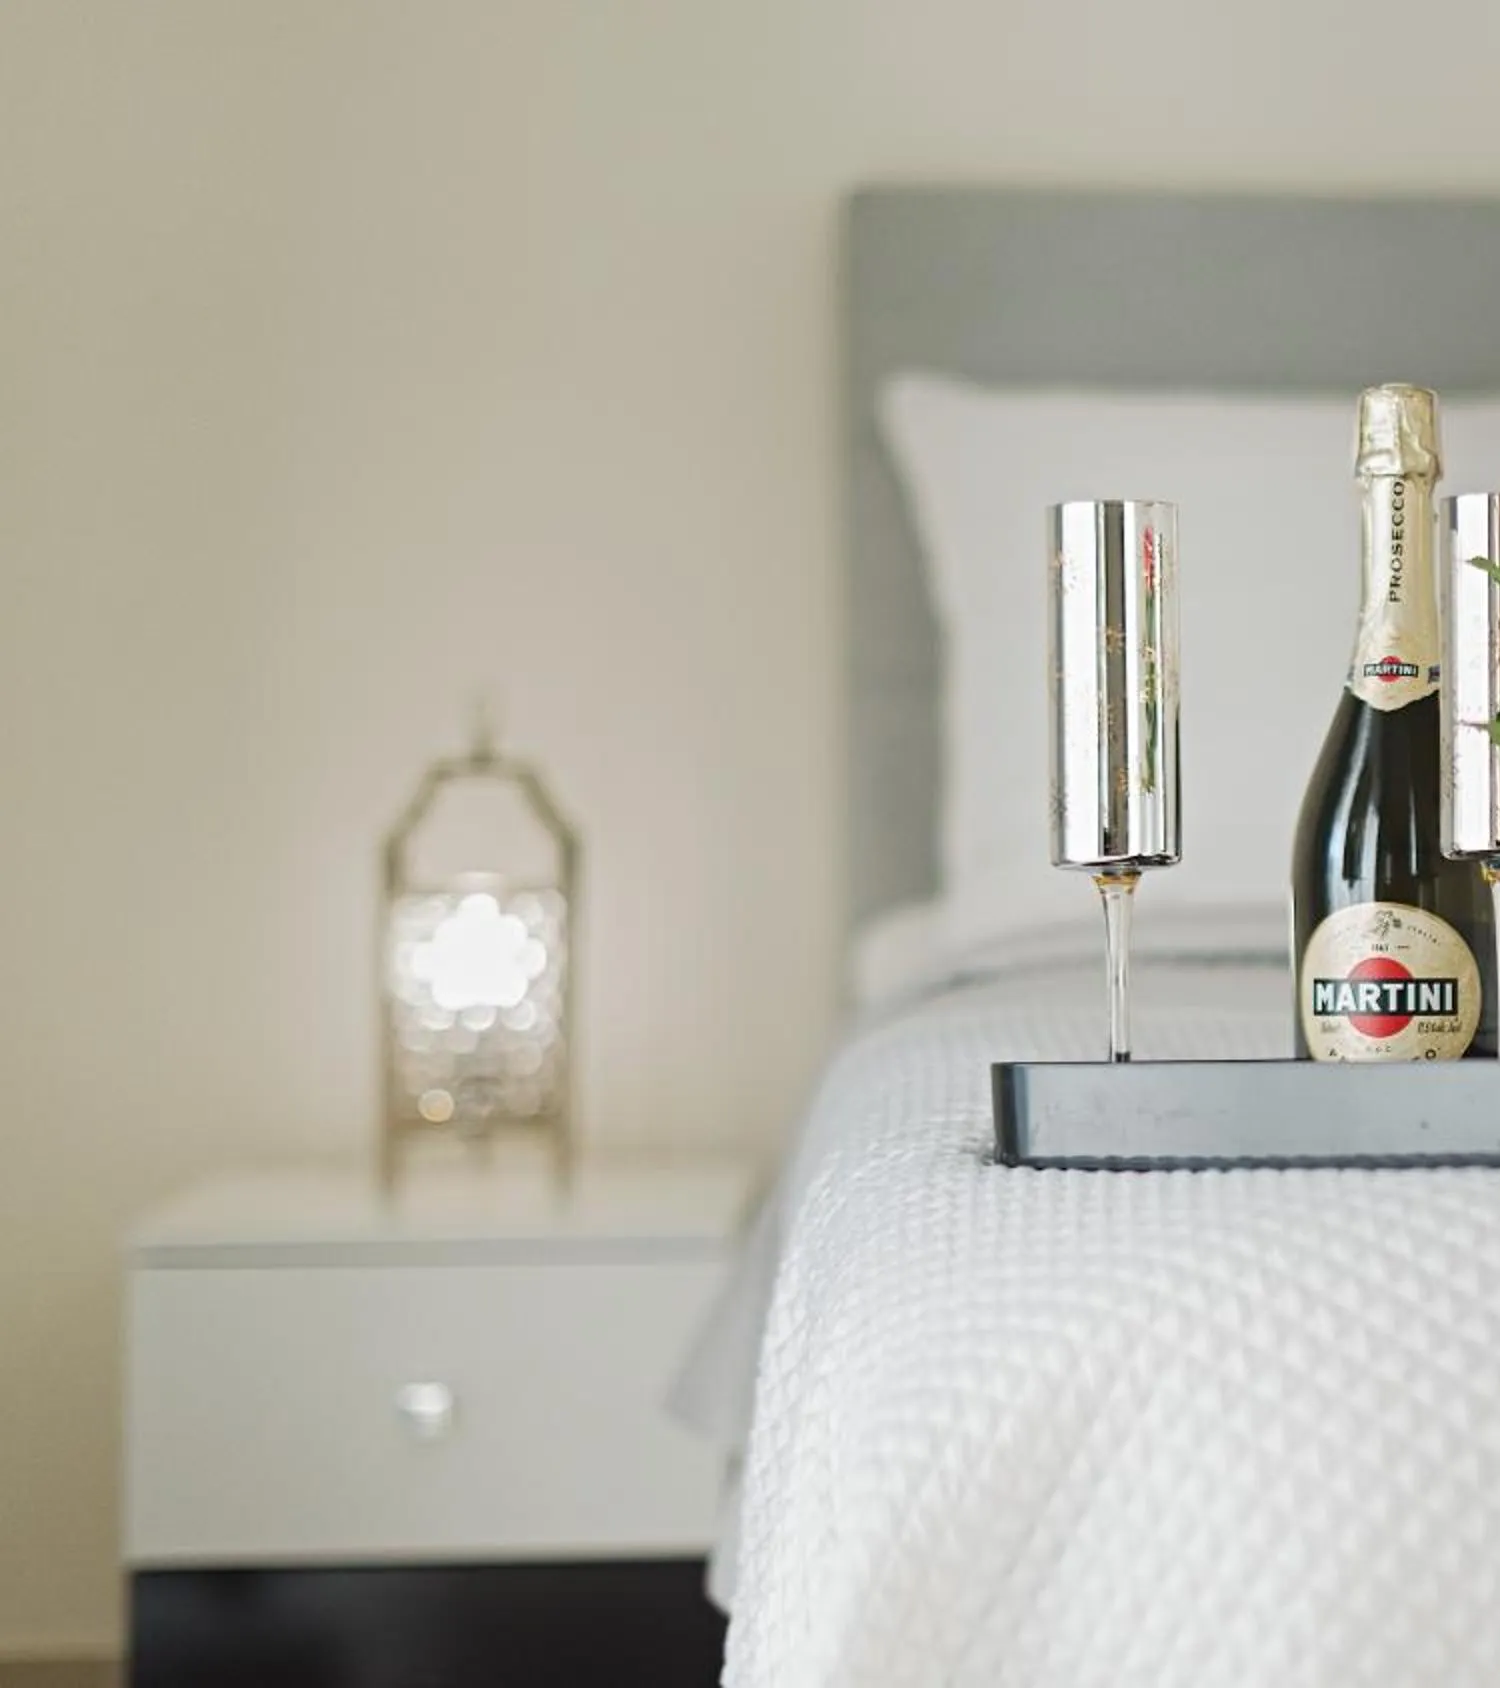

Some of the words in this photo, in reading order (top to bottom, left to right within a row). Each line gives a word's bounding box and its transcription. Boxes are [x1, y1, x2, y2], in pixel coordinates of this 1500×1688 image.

[1389, 481, 1405, 603] PROSECCO
[1365, 664, 1416, 677] MARTINI
[1315, 982, 1453, 1013] MARTINI
